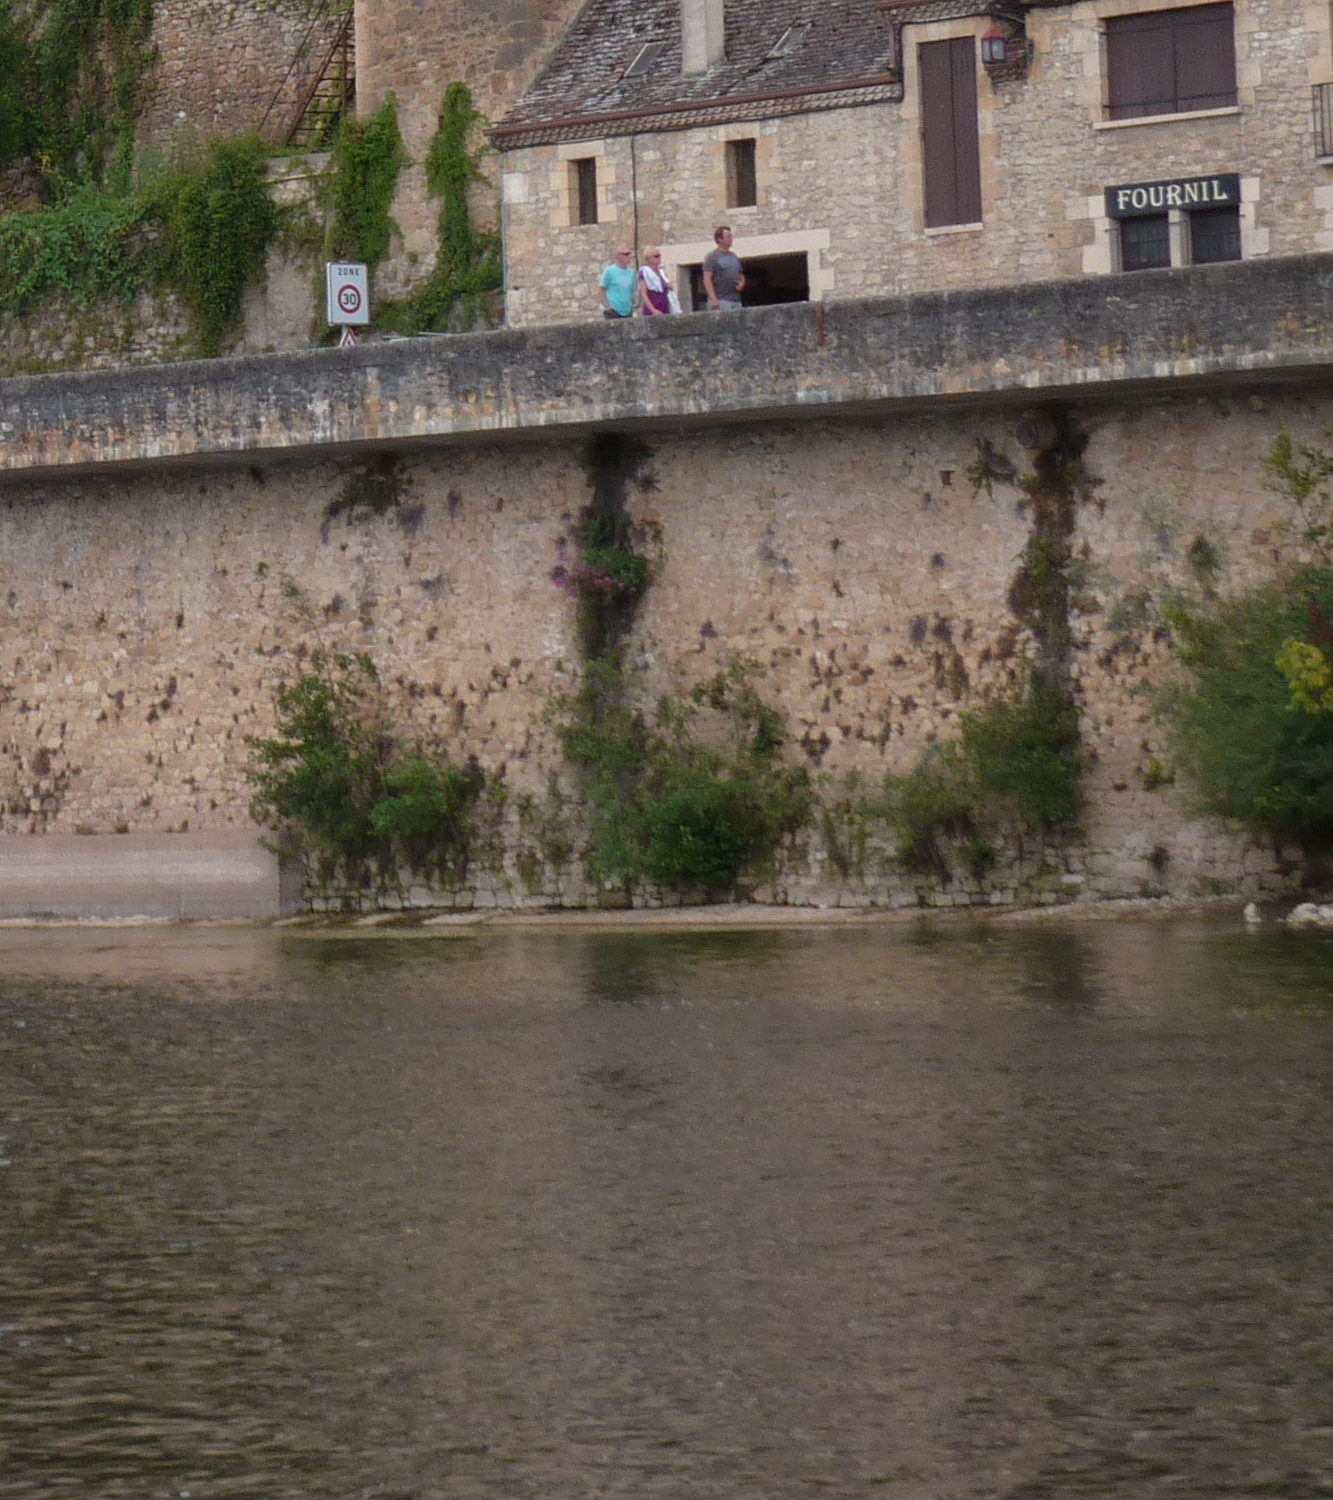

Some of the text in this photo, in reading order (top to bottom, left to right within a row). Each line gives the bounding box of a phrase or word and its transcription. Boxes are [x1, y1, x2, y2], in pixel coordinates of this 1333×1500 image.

[1117, 180, 1228, 210] FOURNIL
[338, 267, 360, 276] ZONE
[343, 293, 357, 306] 30
